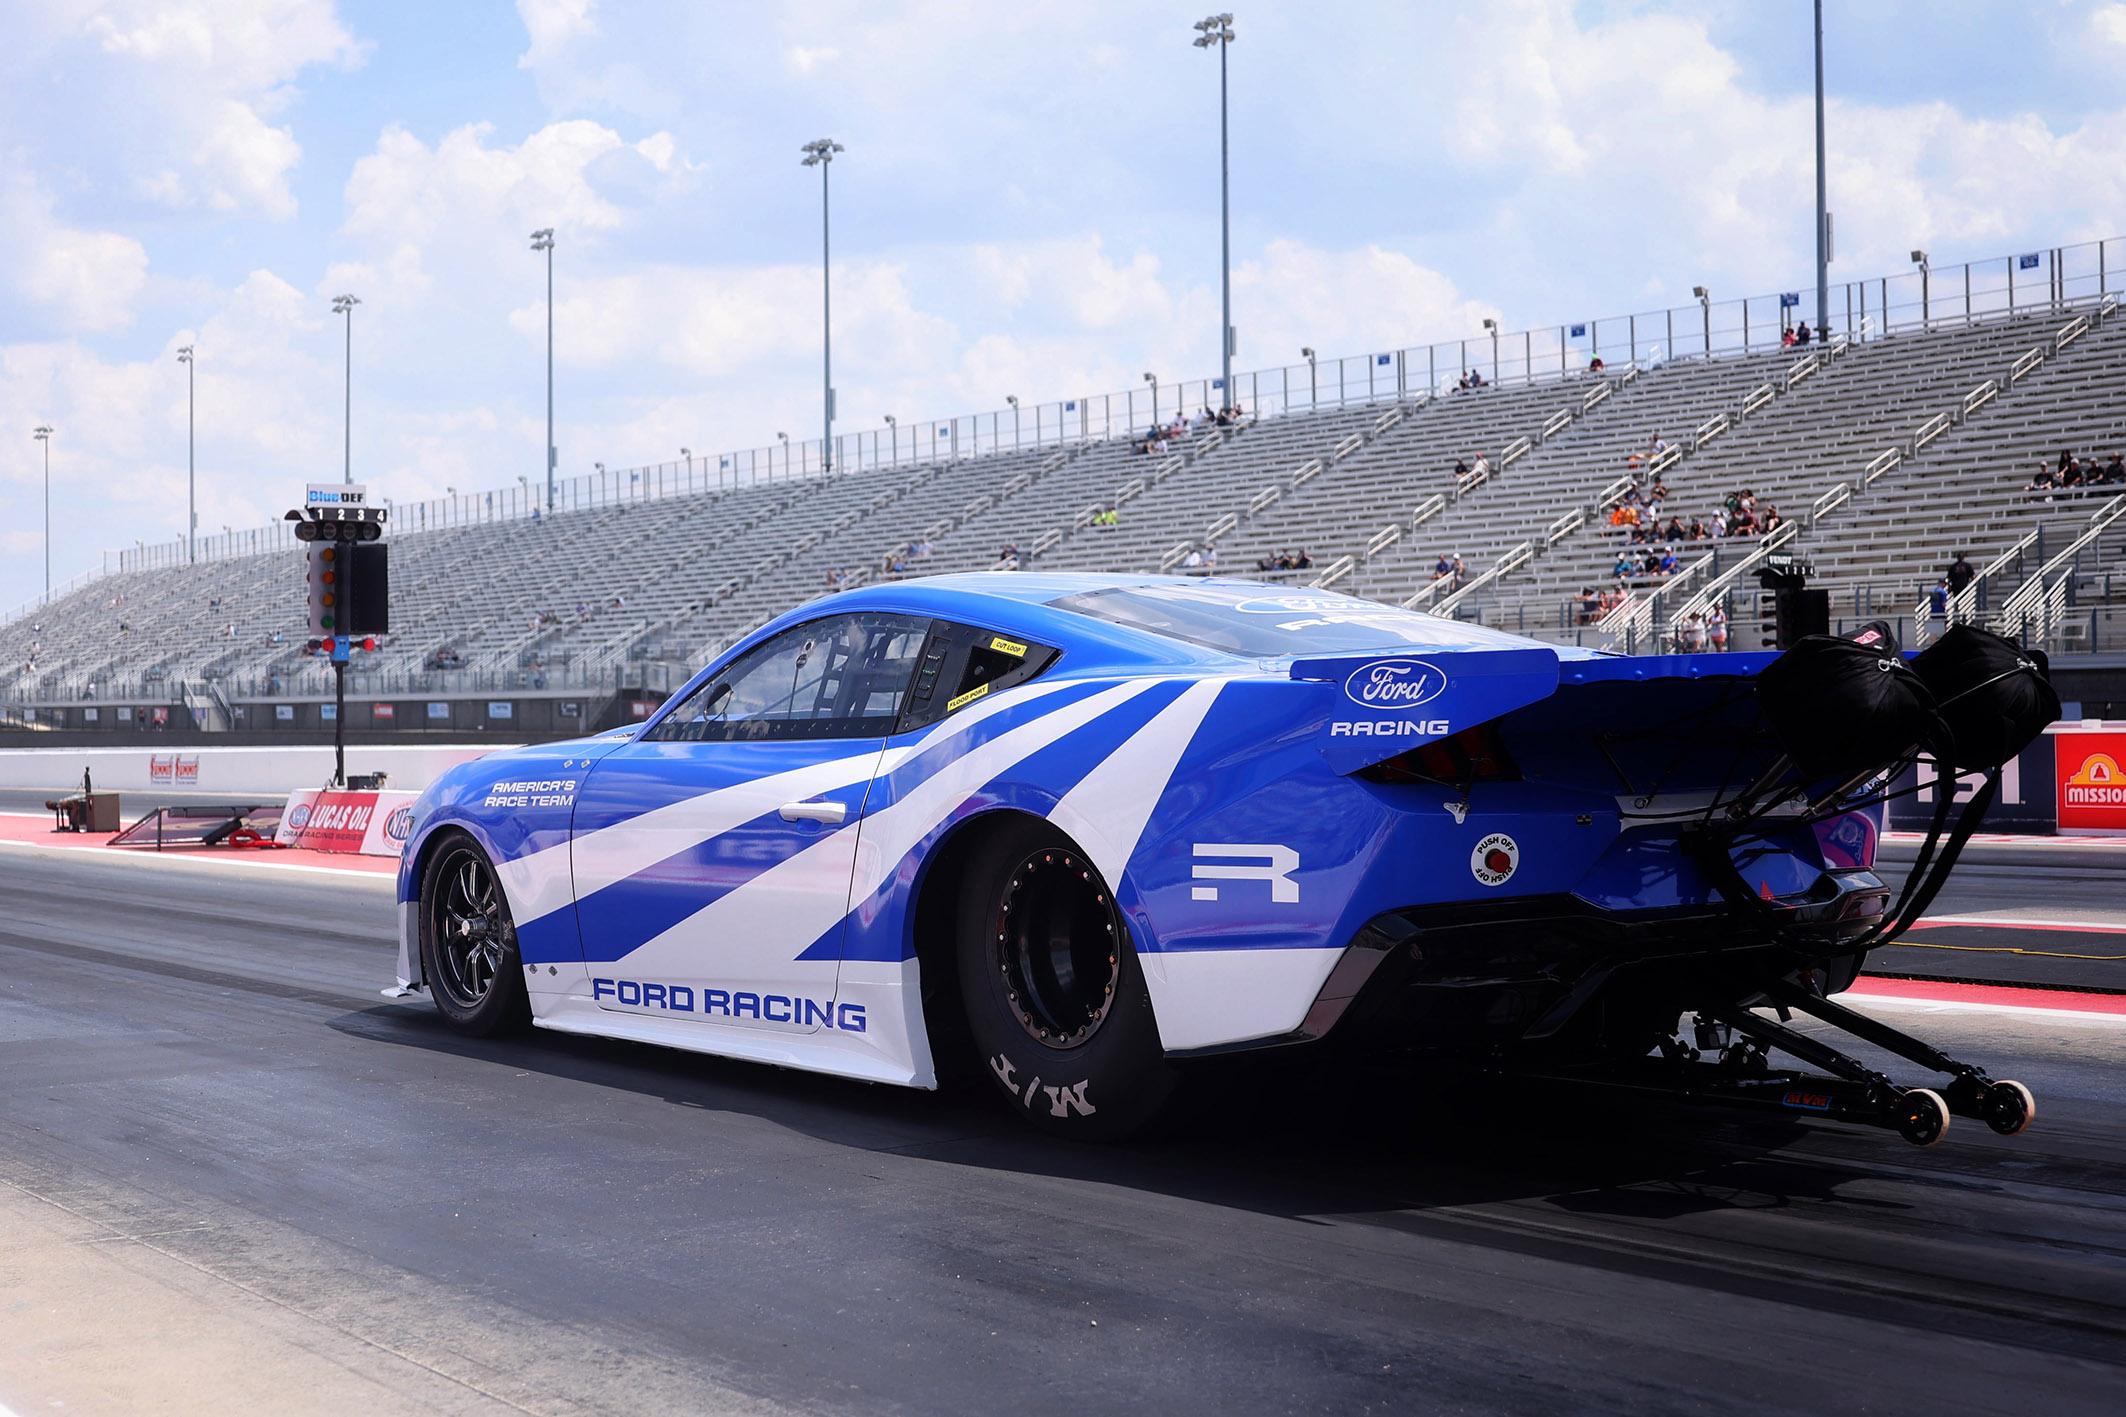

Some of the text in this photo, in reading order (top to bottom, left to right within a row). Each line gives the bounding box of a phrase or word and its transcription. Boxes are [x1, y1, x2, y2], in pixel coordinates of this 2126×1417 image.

[317, 508, 384, 522] 1 2 3 4
[995, 641, 1022, 652] CUT LOOP
[1362, 666, 1428, 701] Ford
[949, 686, 986, 708] FLOOD PORT
[1330, 720, 1450, 736] RACING
[491, 780, 577, 794] AMERICA'S
[2068, 787, 2126, 803] MISSIO
[484, 794, 575, 807] RACE TEAM
[307, 804, 373, 831] LUCAS OIL
[303, 831, 334, 841] RACING
[1477, 836, 1515, 854] PUSH OFF
[1475, 865, 1513, 883] PUSH OFF
[592, 978, 867, 1033] FORD RACING
